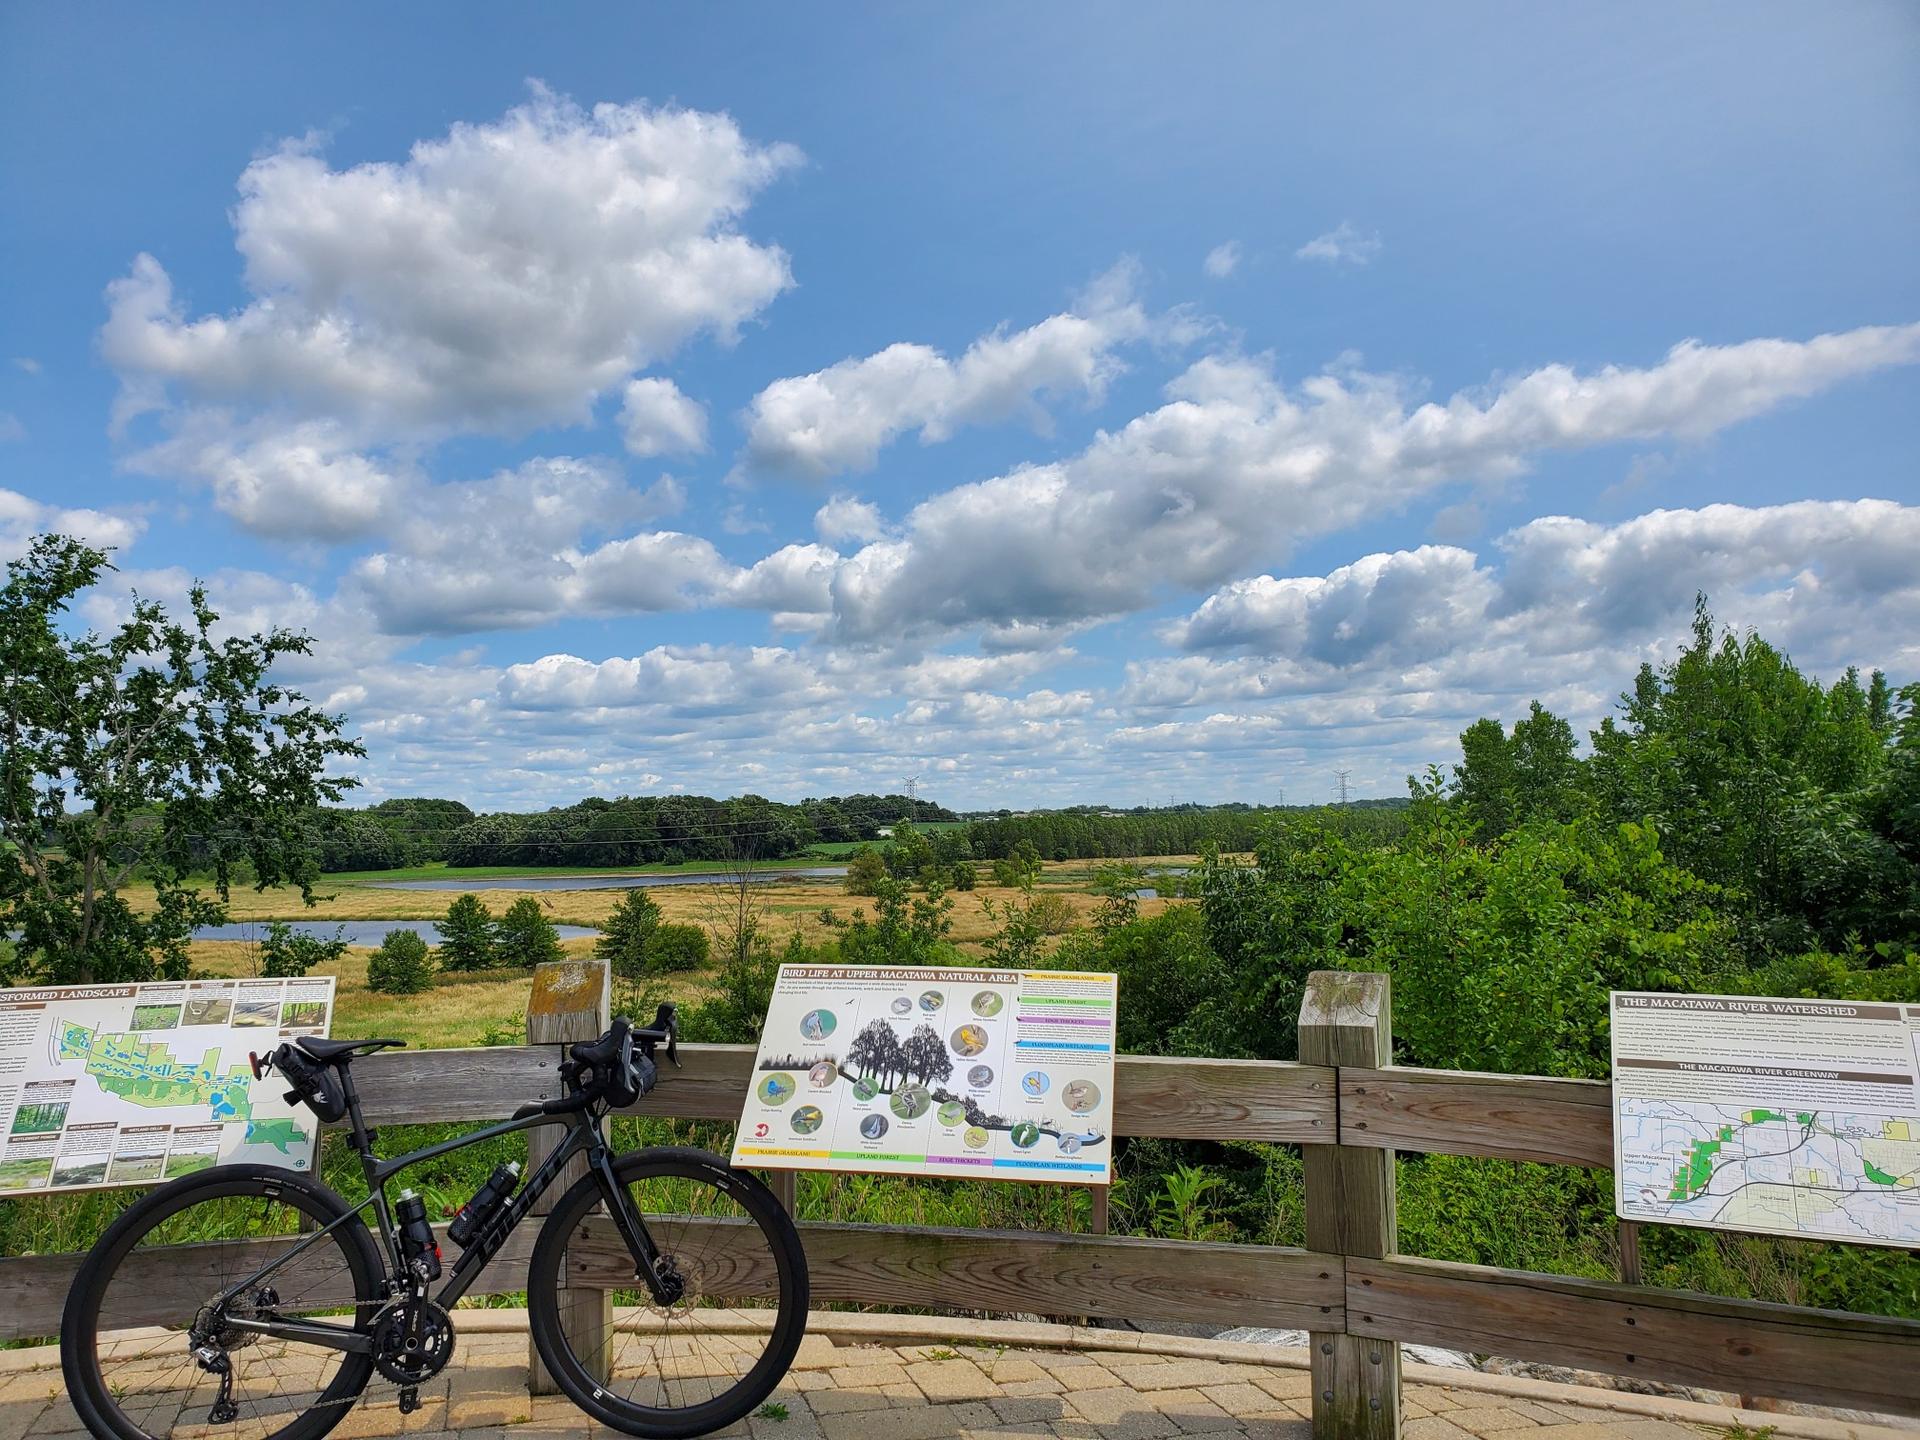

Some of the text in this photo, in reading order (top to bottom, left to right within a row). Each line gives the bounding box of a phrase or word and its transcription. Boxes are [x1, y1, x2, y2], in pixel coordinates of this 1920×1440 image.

[782, 969, 1017, 983] BIRD LIFE AT UPPER MACATAWA NATURAL AREA
[0, 991, 58, 1001] SFORMED
[60, 988, 131, 999] LANDSCAPE
[1621, 997, 1858, 1017] THE MACATAWA RIVER WATERSHED
[1698, 1064, 1753, 1074] MACATAWA
[1755, 1067, 1783, 1076] RIVER
[1785, 1069, 1840, 1080] GREENWAY
